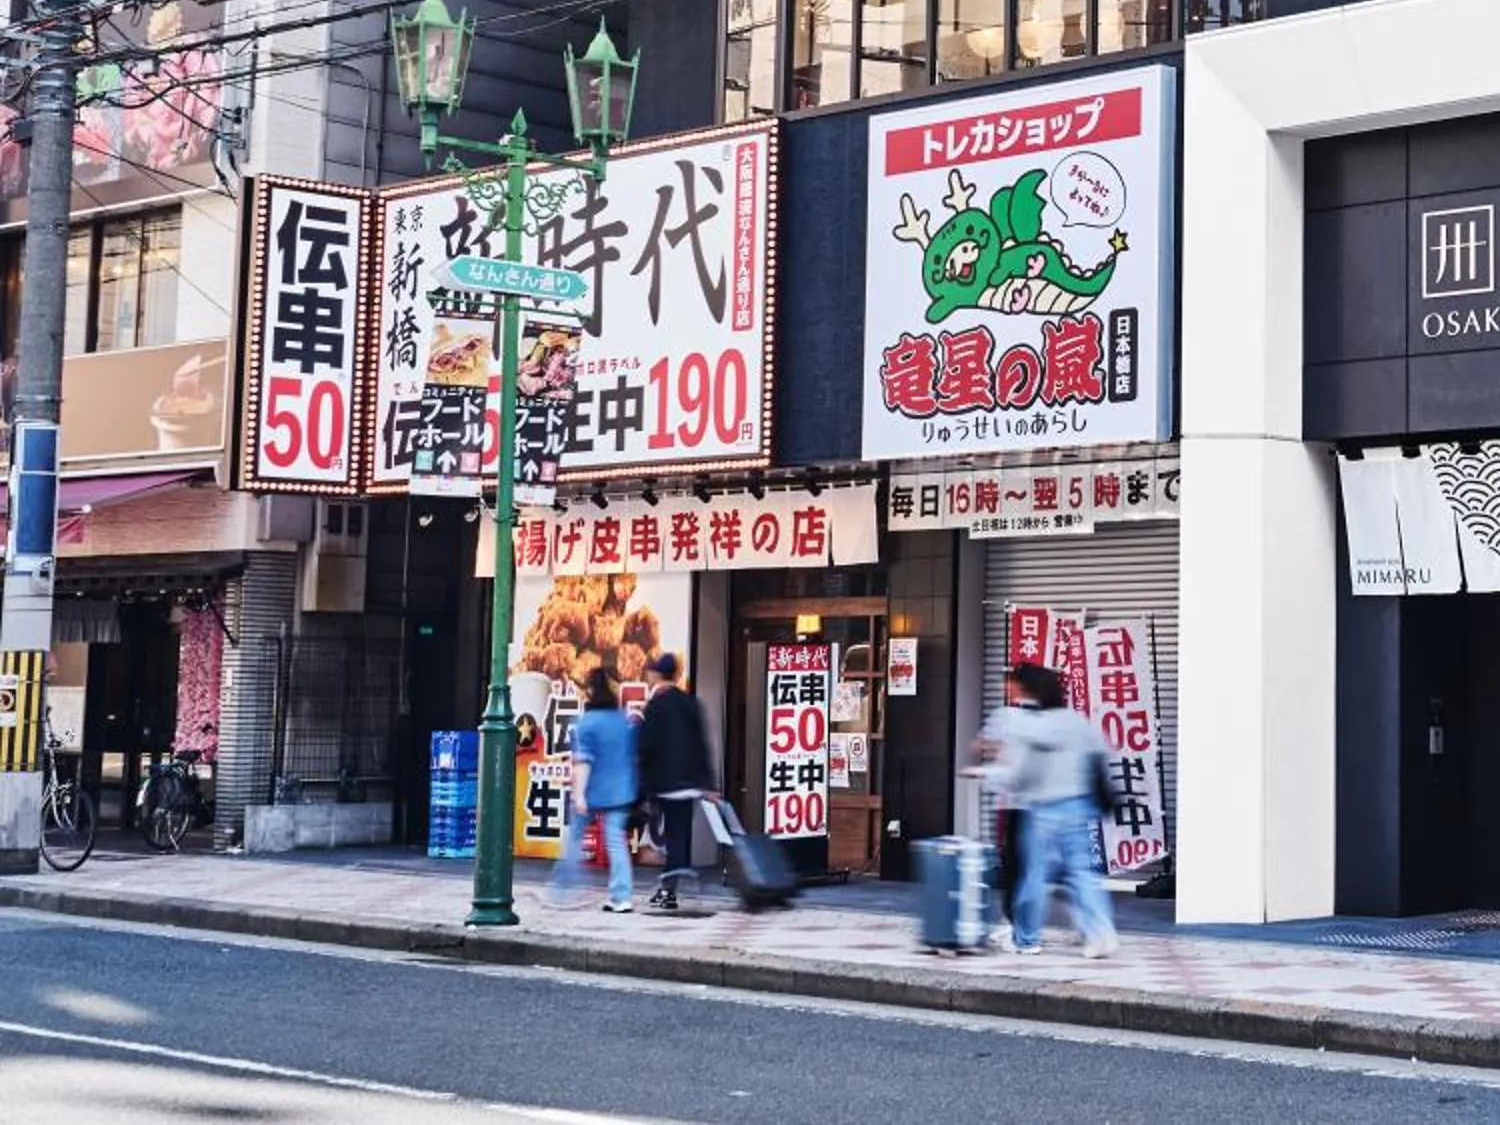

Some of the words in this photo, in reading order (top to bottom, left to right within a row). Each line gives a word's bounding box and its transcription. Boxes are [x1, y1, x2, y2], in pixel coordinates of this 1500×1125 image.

[921, 96, 1105, 166] トレカショップ
[469, 262, 571, 292] なんさん通り
[881, 313, 1104, 415] 竜星の嵐
[421, 397, 482, 422] フード
[921, 408, 1088, 443] りゅうせいのあらし
[418, 424, 486, 448] ホール
[516, 505, 828, 569] 揚げ皮串発祥の店
[1357, 567, 1431, 584] MIMARU
[771, 673, 825, 706] 伝串
[769, 759, 825, 794] 生中
